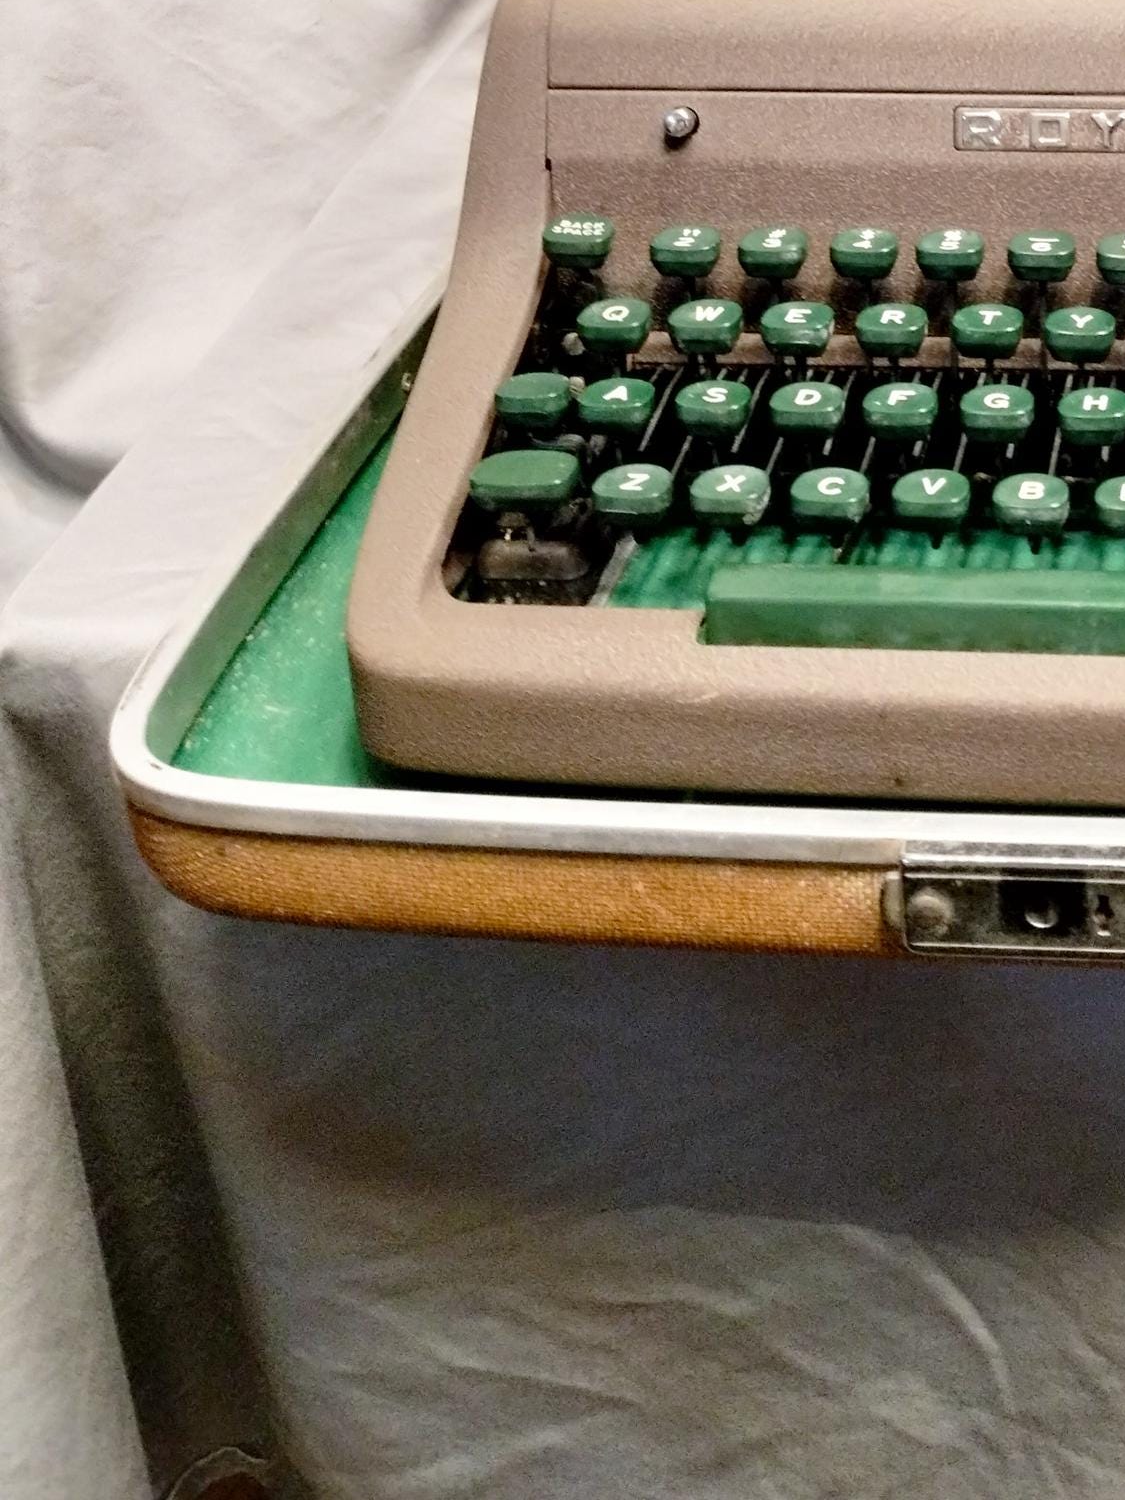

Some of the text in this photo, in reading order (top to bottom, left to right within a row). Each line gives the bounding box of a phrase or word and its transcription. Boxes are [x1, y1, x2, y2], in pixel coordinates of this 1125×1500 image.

[601, 305, 630, 322] Q
[692, 305, 725, 322] W
[784, 307, 812, 324] E
[879, 309, 906, 325] R
[978, 309, 1003, 326] T
[1070, 313, 1094, 329] Y
[602, 385, 628, 402] A
[702, 386, 729, 403] S
[794, 388, 822, 406] D
[887, 388, 917, 406] F
[983, 392, 1010, 409] G
[1082, 394, 1109, 411] H
[618, 472, 651, 491] Z
[715, 473, 747, 493] X
[817, 476, 846, 496] C
[921, 476, 947, 496] V
[1017, 480, 1046, 500] B
